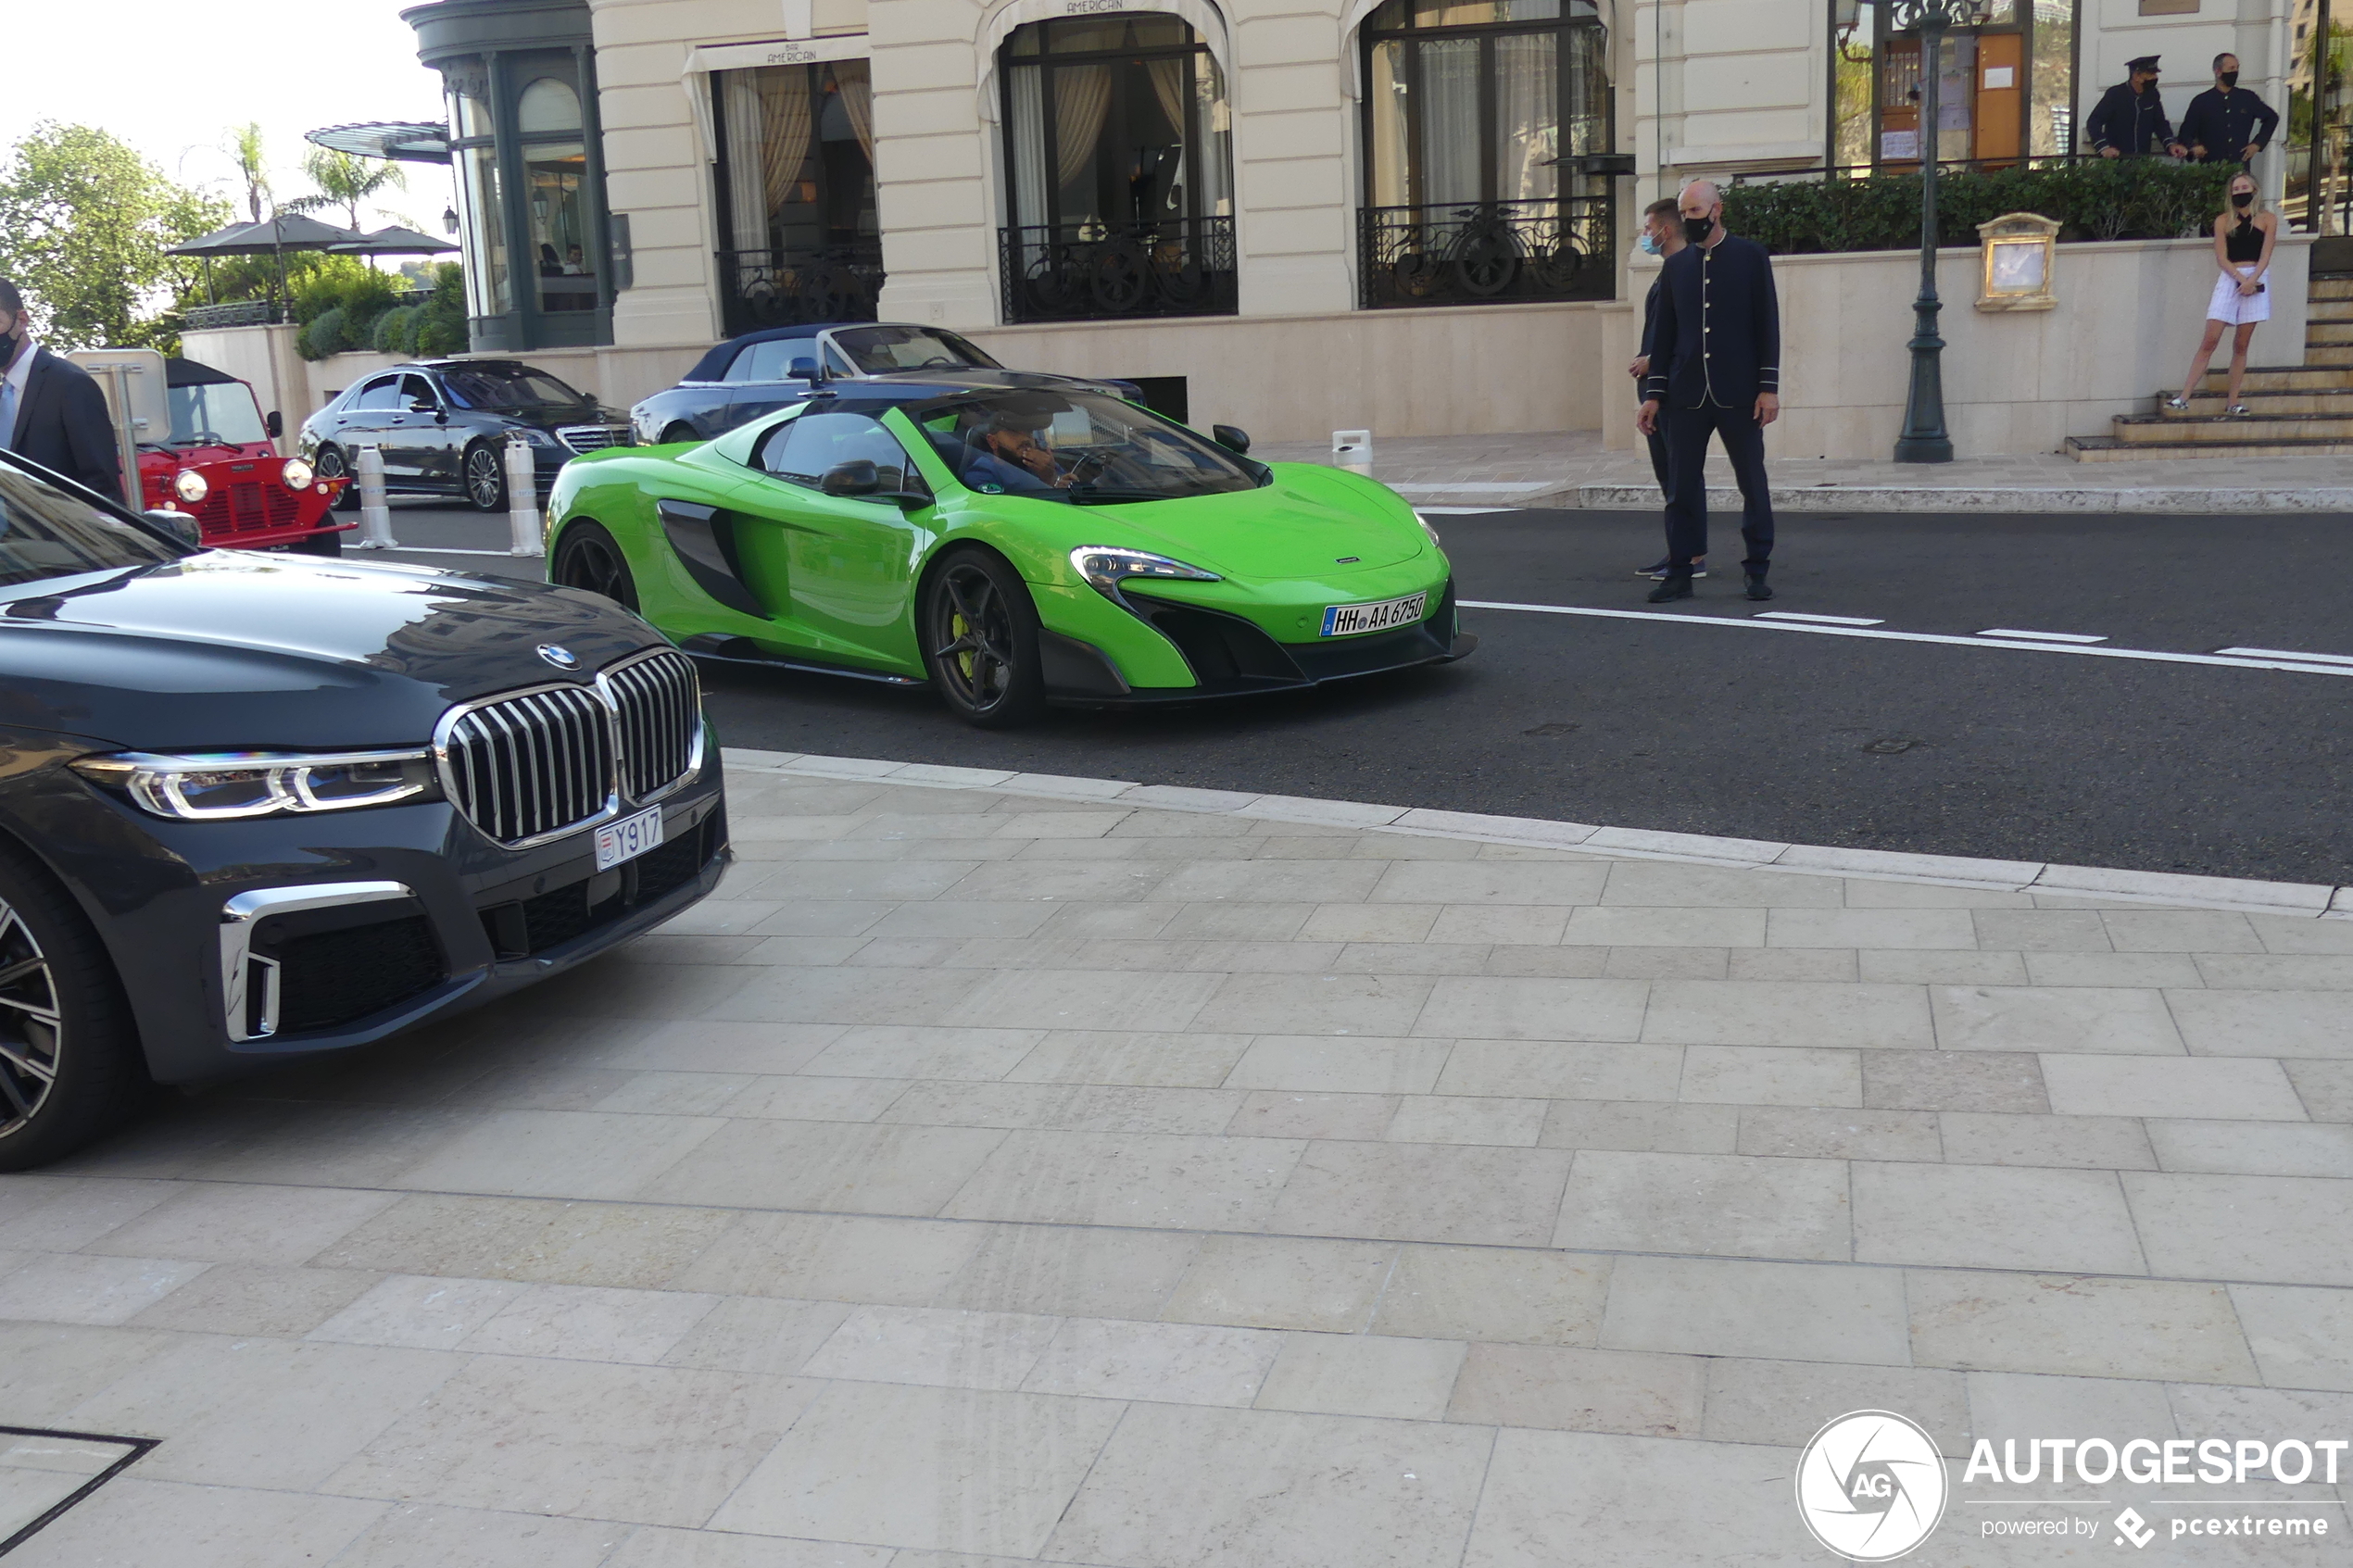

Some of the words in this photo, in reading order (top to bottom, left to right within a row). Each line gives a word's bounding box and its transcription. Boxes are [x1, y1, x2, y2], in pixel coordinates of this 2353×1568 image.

[1066, 0, 1123, 14] AMERICAN
[785, 43, 799, 52] BAR
[767, 51, 817, 64] AMERICAN
[1334, 609, 1360, 632] HH
[1367, 605, 1390, 629] AA
[1390, 596, 1424, 624] 6750
[615, 810, 660, 858] Y917
